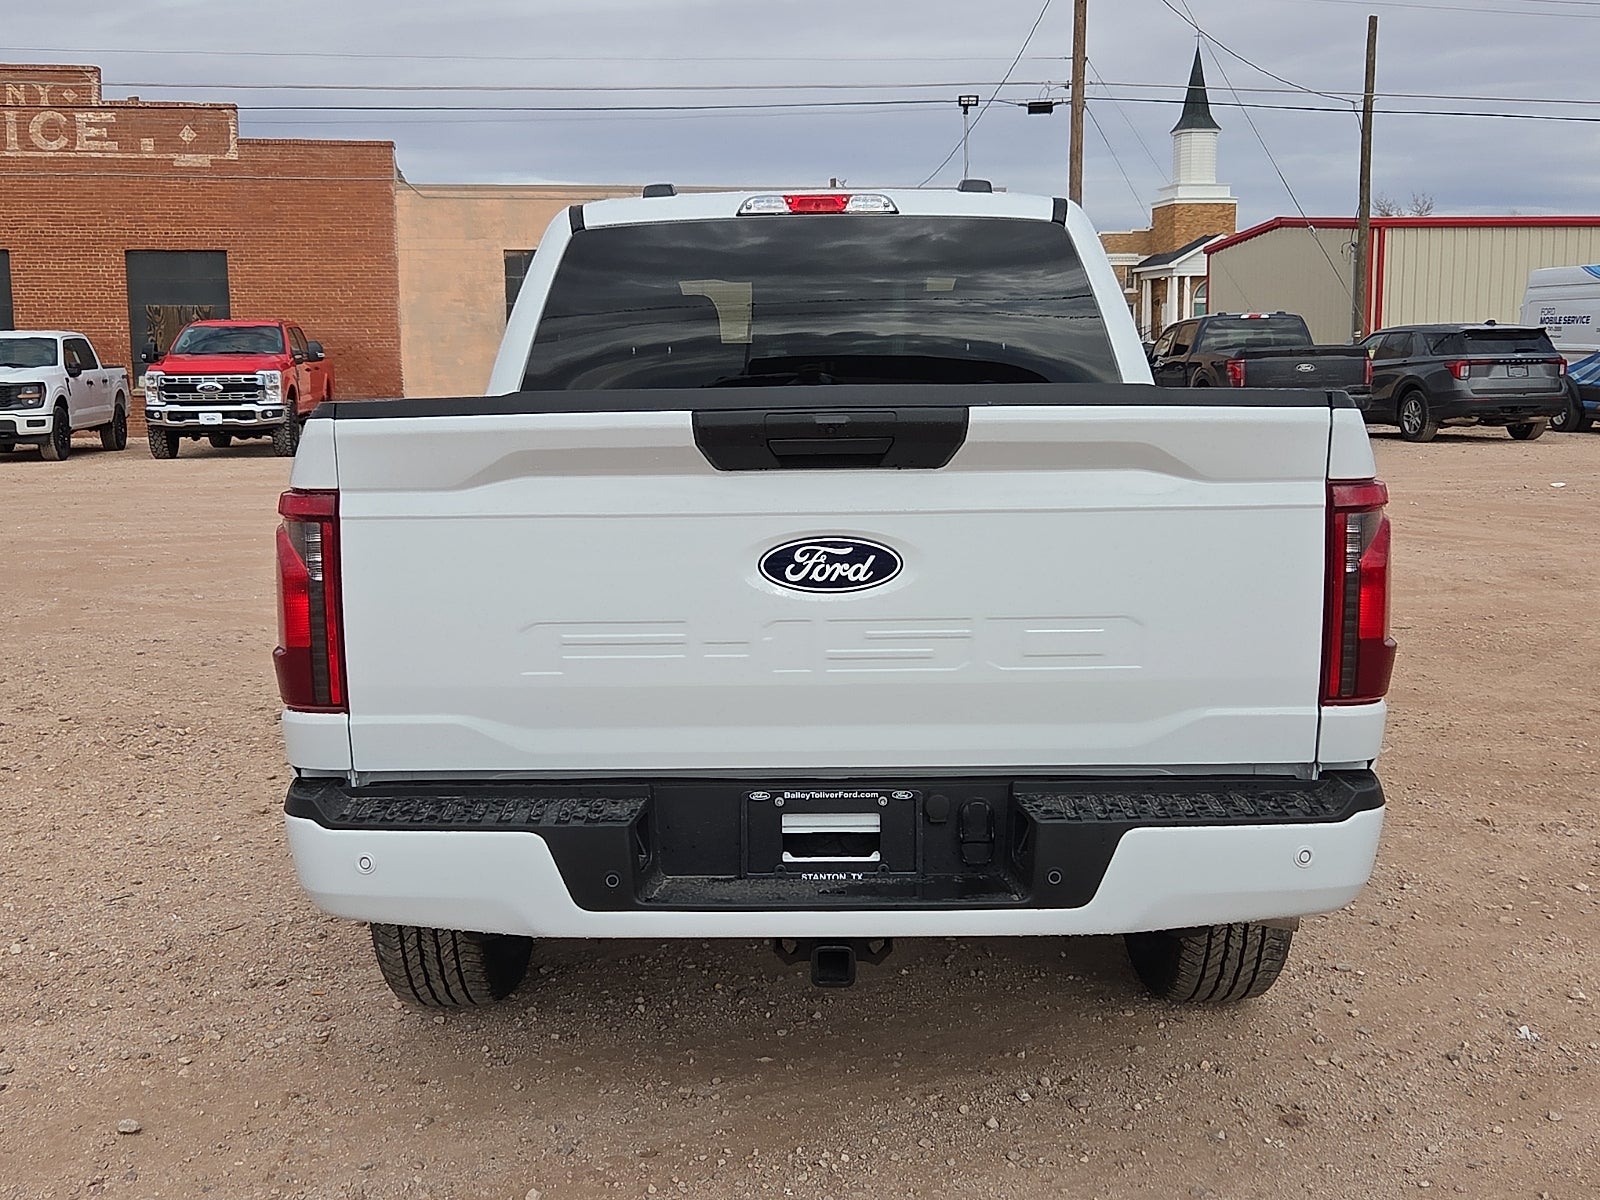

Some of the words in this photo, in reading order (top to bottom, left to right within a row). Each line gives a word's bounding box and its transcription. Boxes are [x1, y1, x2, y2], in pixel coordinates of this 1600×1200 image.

[1539, 316, 1562, 325] MOBILE
[1563, 315, 1591, 325] SERVICE
[518, 616, 1143, 677] F-150
